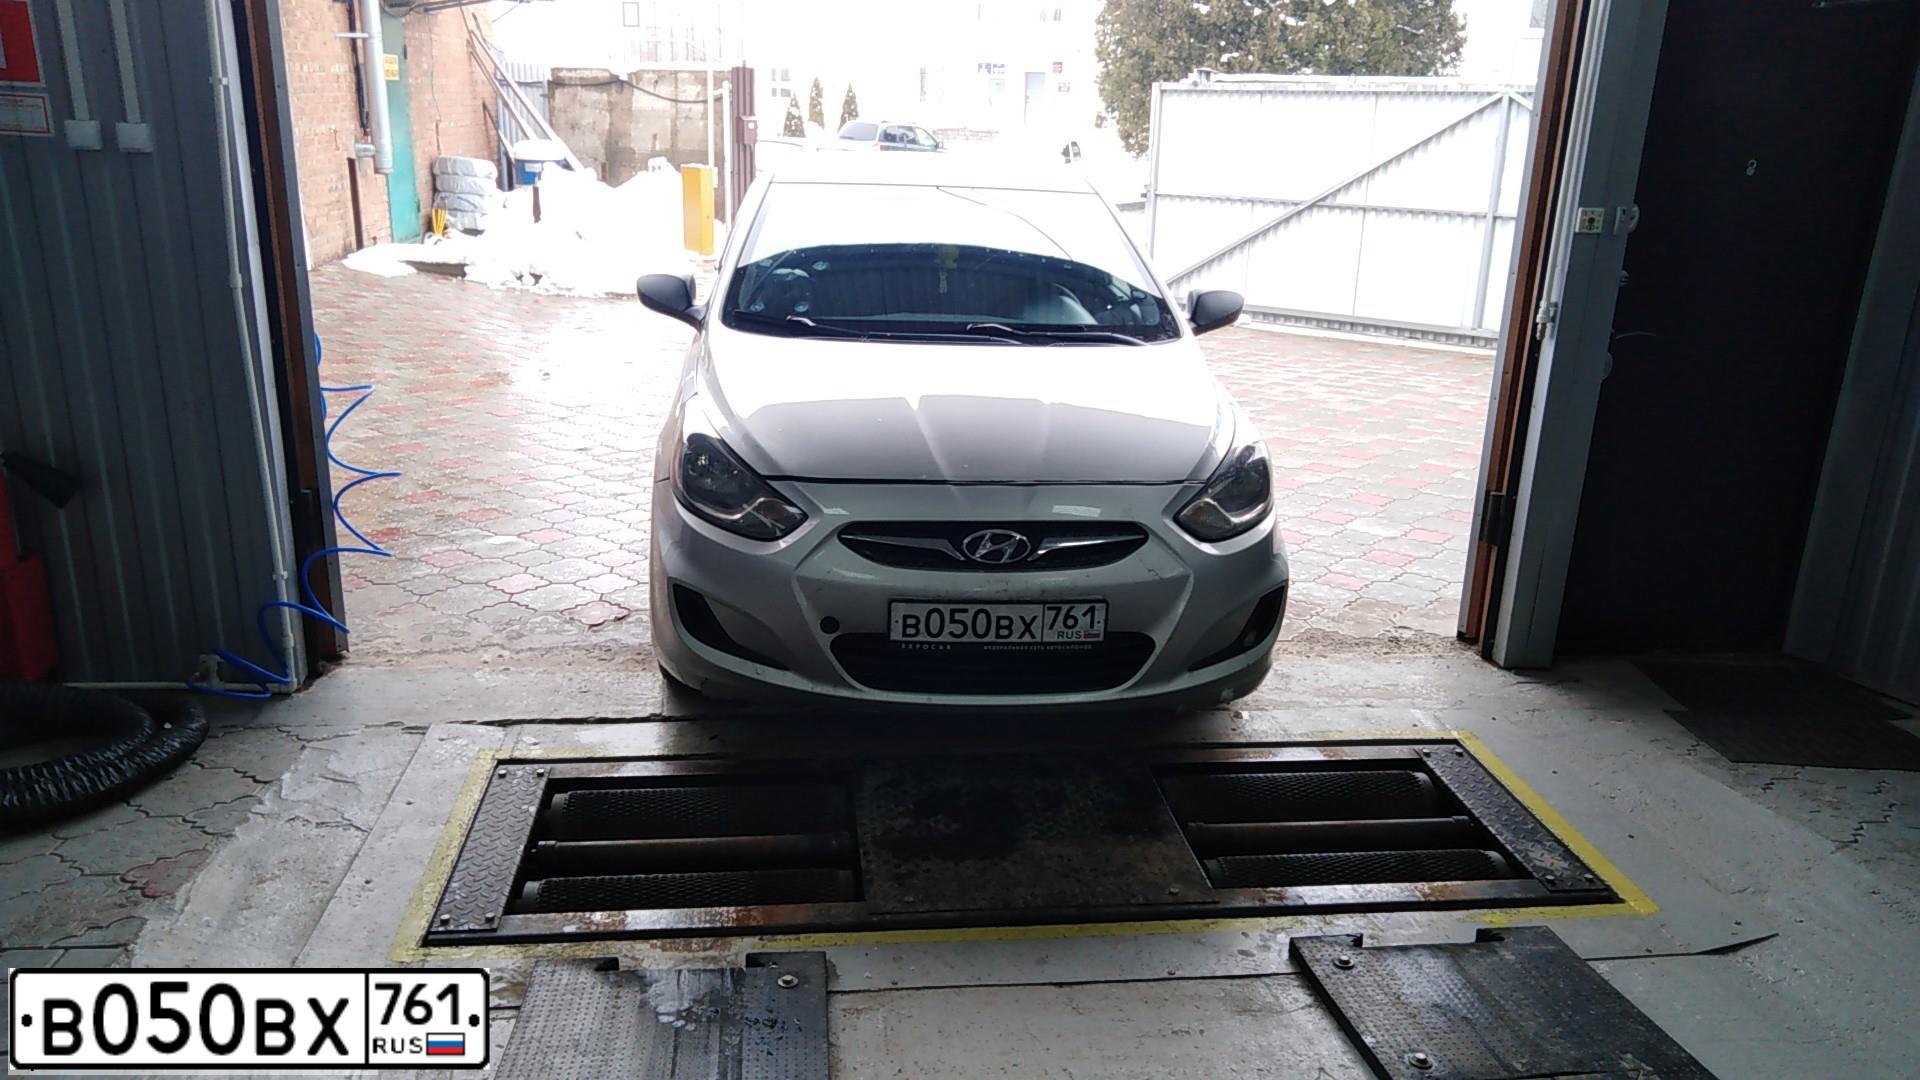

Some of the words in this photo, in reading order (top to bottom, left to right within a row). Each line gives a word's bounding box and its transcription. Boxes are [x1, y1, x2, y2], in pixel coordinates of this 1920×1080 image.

[902, 606, 1040, 640] В050ВХ
[1046, 605, 1097, 630] 761
[1056, 630, 1083, 640] RUS
